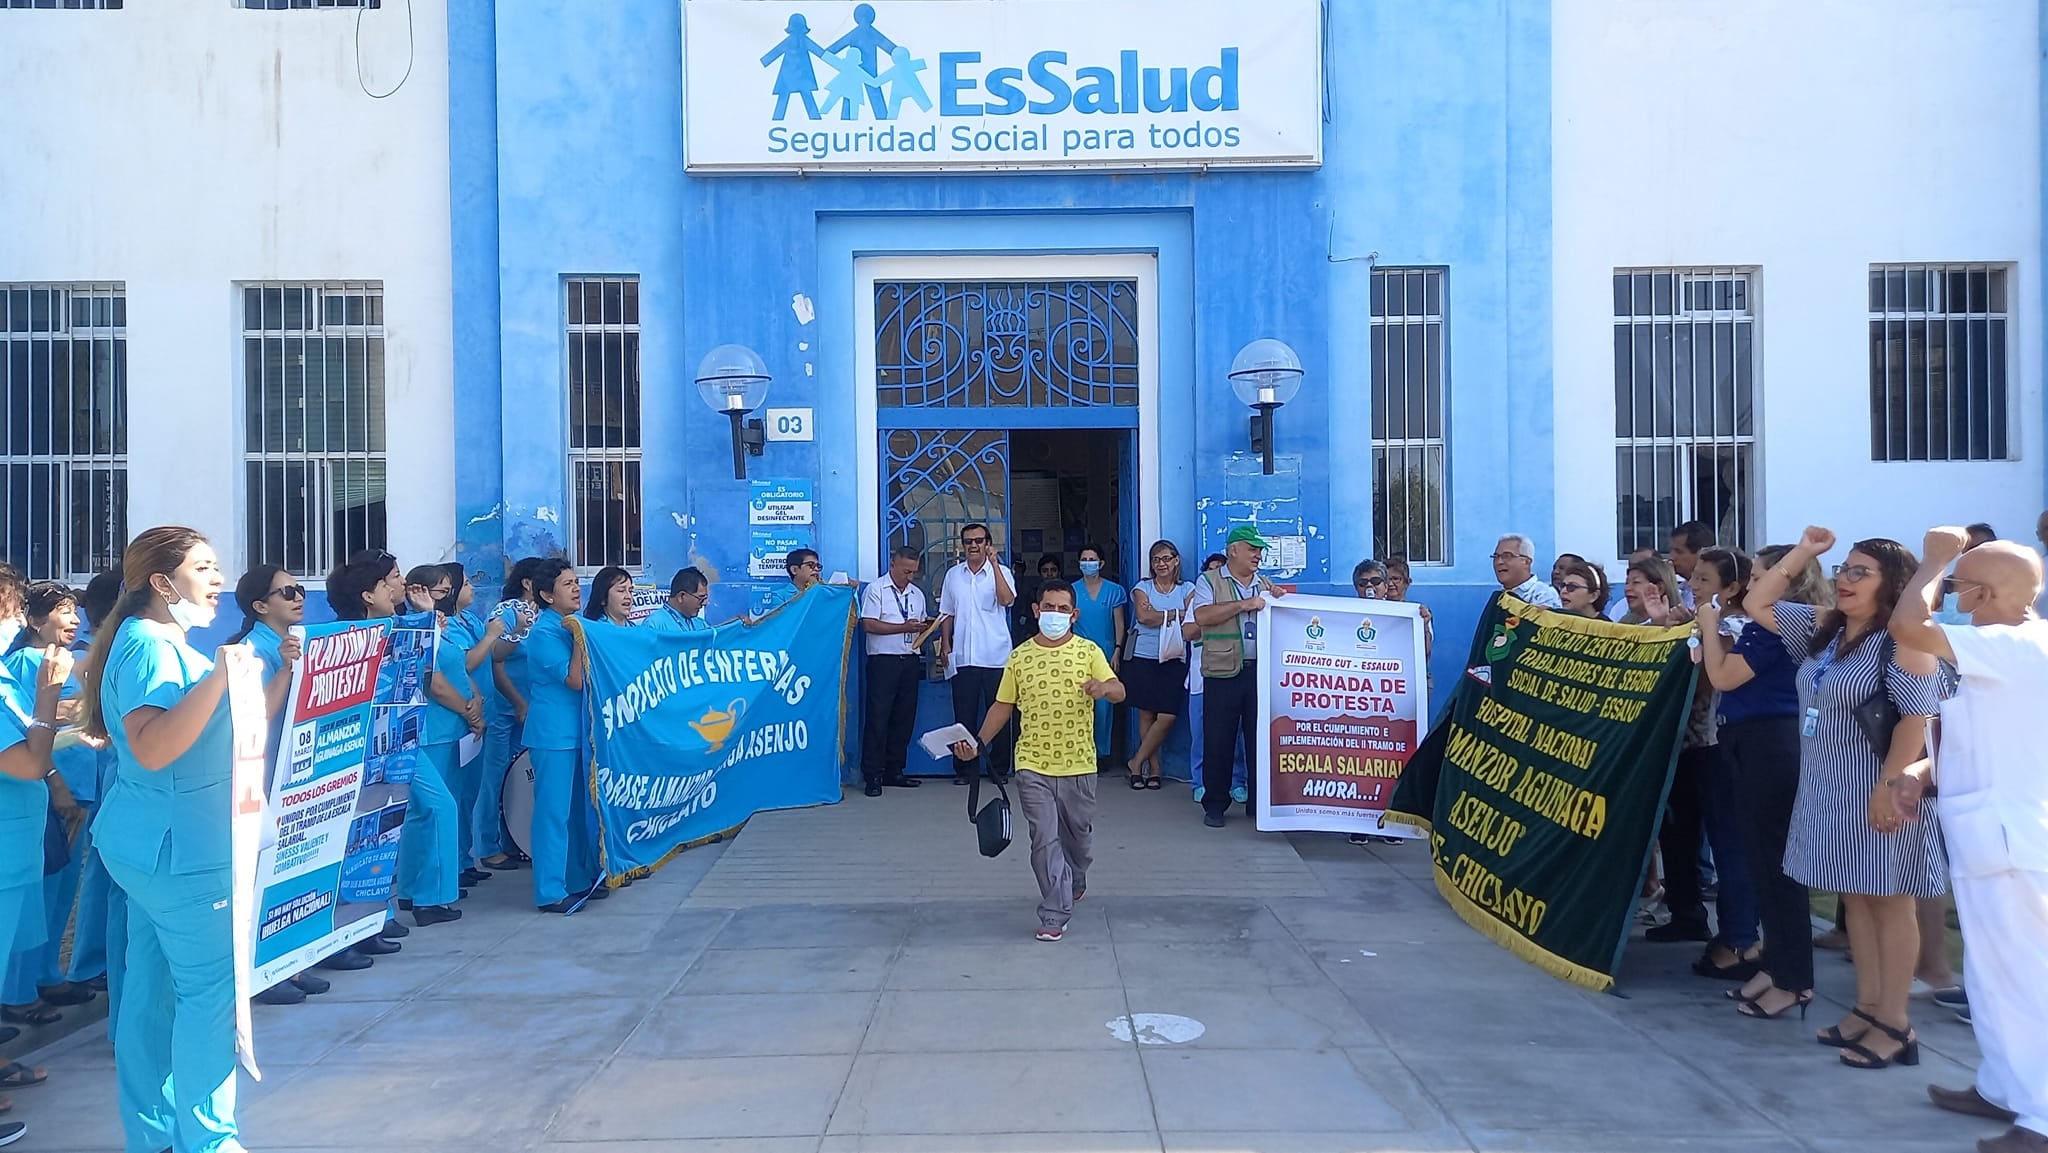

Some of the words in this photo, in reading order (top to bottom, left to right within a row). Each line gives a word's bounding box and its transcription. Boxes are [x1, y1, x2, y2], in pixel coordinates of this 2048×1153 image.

[939, 47, 1239, 117] EsSalud
[767, 124, 936, 159] Seguridad
[952, 123, 1047, 151] Social
[1063, 126, 1135, 156] para
[1149, 119, 1240, 149] todos
[778, 416, 802, 433] 03
[308, 626, 367, 674] PLANTÓN
[365, 625, 384, 659] DE
[1530, 627, 1586, 654] SINDICATO
[1583, 636, 1634, 662] CENTRO
[678, 648, 704, 688] DE
[1285, 654, 1332, 667] SINDICATO
[1334, 659, 1352, 669] CUT
[1361, 661, 1400, 671] ESSALUD
[1515, 647, 1601, 684] TRABAJADORES
[1597, 665, 1620, 688] DEL
[1618, 669, 1661, 693] SEGURO
[306, 661, 368, 709] PROTESTA
[1280, 671, 1374, 693] JORNADA
[1380, 678, 1406, 694] DE
[1507, 668, 1543, 697] SOCIAL
[1540, 680, 1560, 703] DE
[1556, 685, 1599, 714] SALUD
[1291, 692, 1395, 713] PROTESTA
[1296, 722, 1312, 732] POR
[1313, 723, 1322, 733] EL
[1324, 724, 1380, 736] CUMPLIMIENTO
[1383, 727, 1388, 737] E
[1474, 696, 1534, 744] HOSPITAL
[299, 730, 311, 746] 08
[316, 722, 361, 750] ALMANZOR
[744, 720, 808, 760] ASENJO
[1280, 735, 1344, 747] IMPLEMENTACIÓN
[1345, 738, 1361, 748] DEL
[1361, 740, 1366, 749] II
[1368, 740, 1394, 751] TRAMO
[1395, 742, 1406, 752] DE
[1280, 754, 1332, 773] ESCALA
[282, 789, 312, 808] TODOS
[312, 784, 326, 799] LOS
[326, 771, 358, 792] GREMIOS
[1303, 779, 1381, 801] AHORA...!
[281, 809, 304, 826] UNIDOS
[332, 802, 351, 819] ESCALA
[355, 886, 390, 897] CHICLAYO
[1452, 853, 1547, 936] CHICLAYO
